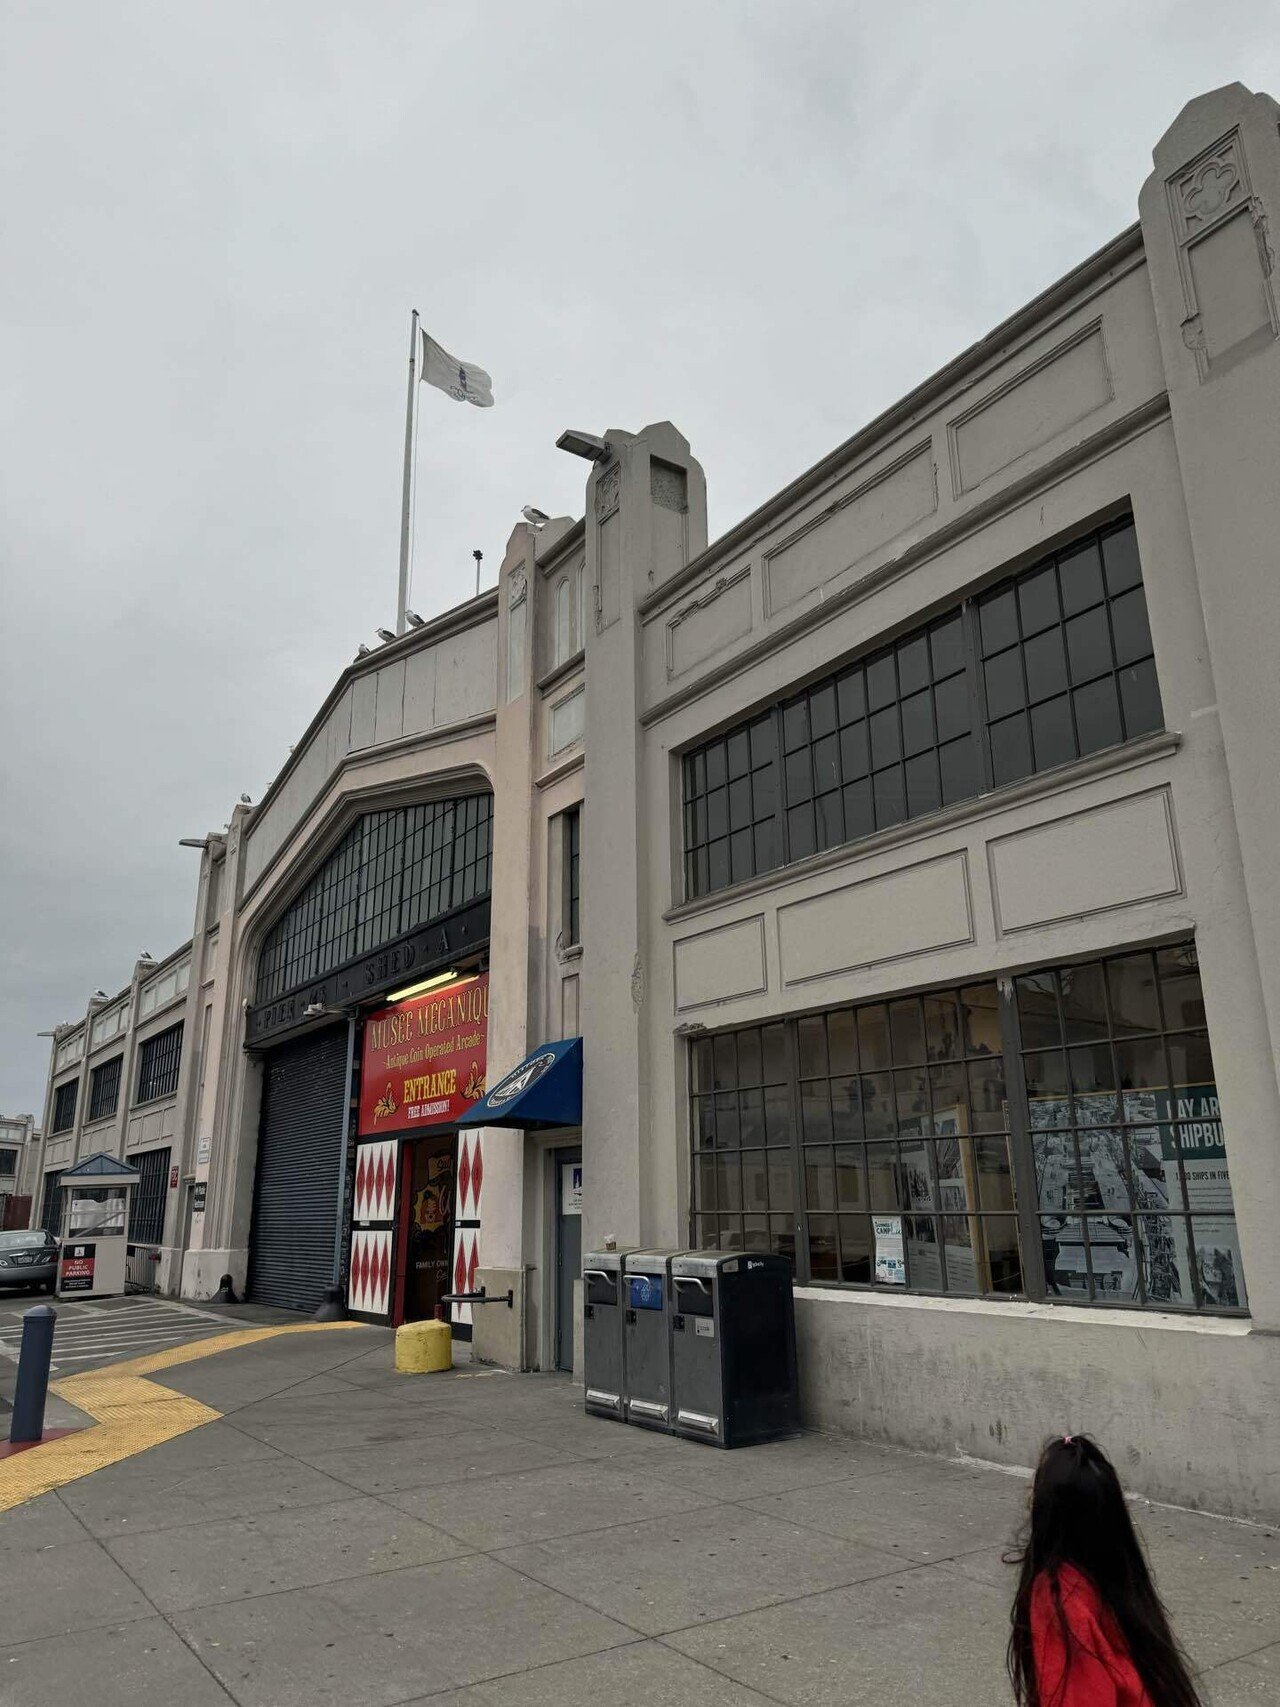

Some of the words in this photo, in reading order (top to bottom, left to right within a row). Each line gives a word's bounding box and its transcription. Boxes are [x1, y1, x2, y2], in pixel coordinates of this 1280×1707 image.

[364, 943, 416, 985] SHED
[435, 927, 450, 953] A
[370, 1011, 414, 1052] MUSEE
[386, 1052, 409, 1070] Antique
[409, 1047, 424, 1063] Coin
[425, 1037, 455, 1062] Operated
[455, 1030, 481, 1051] Arcade
[402, 1068, 457, 1104] ENTRANCE
[407, 1105, 420, 1119] FREE
[1192, 1170, 1209, 1181] SHIPS
[1209, 1170, 1217, 1180] IN
[1217, 1170, 1230, 1180] FIVE
[415, 1260, 435, 1270] FAMILY
